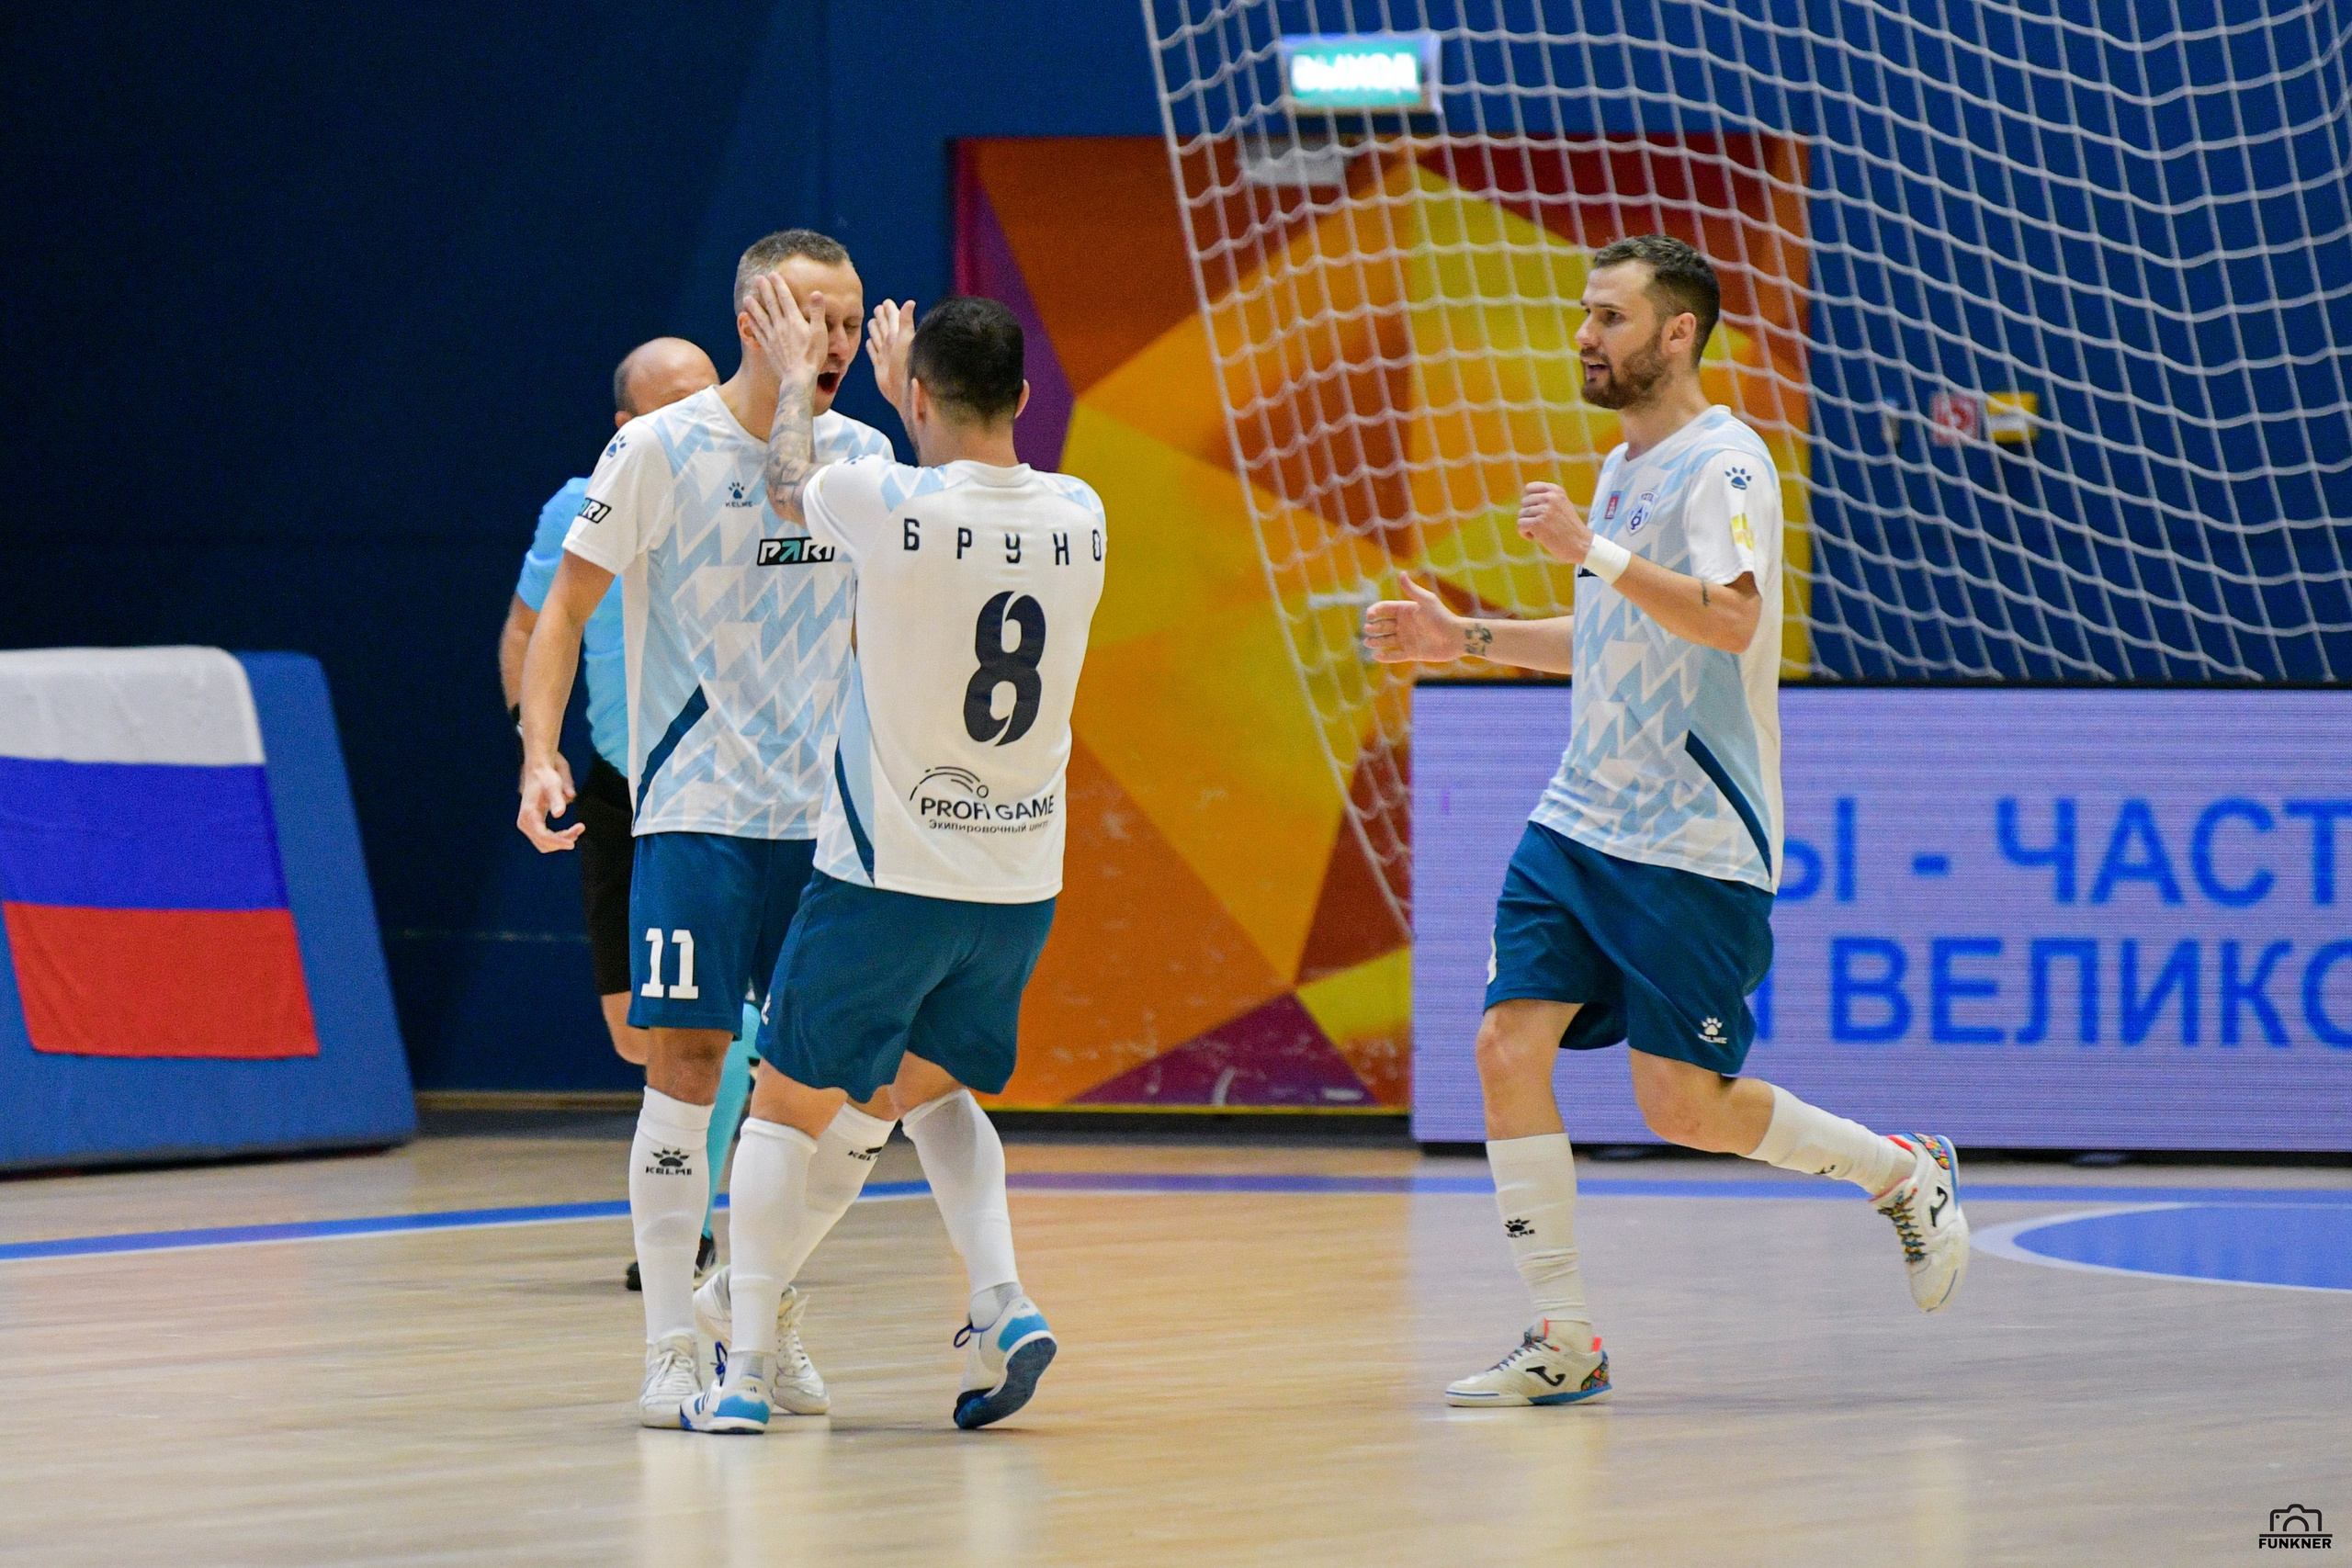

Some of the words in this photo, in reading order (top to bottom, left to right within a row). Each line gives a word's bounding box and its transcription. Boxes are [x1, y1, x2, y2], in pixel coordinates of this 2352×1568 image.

[903, 517, 1102, 566] БРУНО
[963, 590, 1047, 748] 8
[995, 795, 1055, 820] GAME
[640, 928, 699, 999] 11
[645, 1166, 693, 1176] KELME
